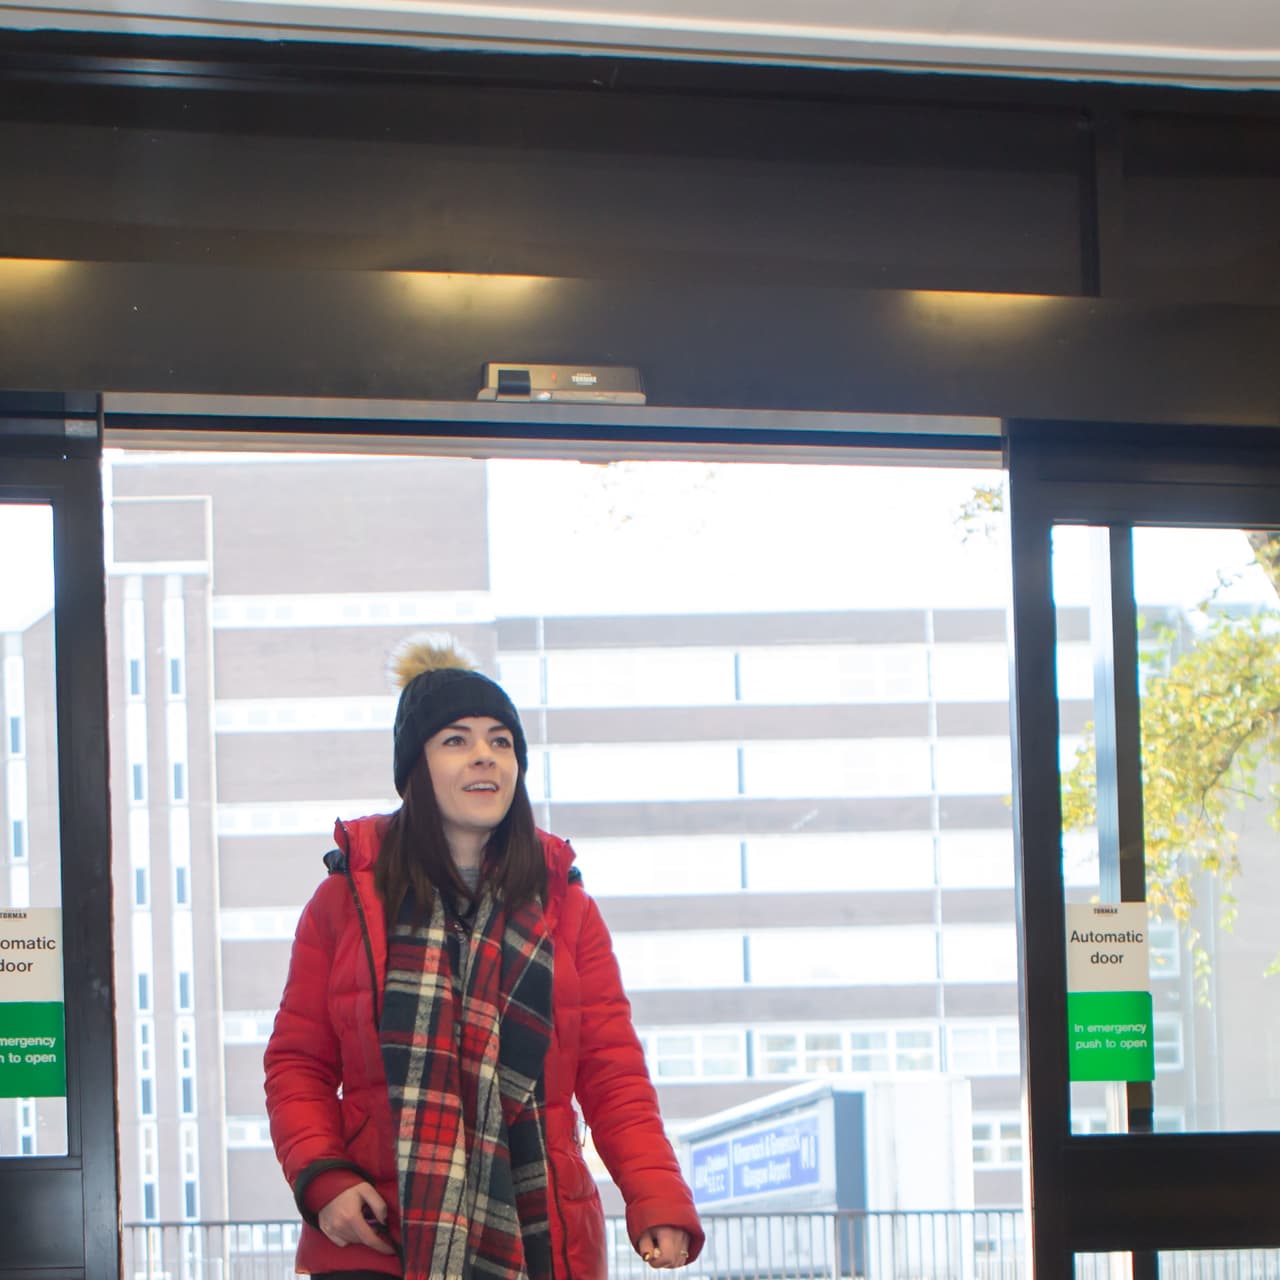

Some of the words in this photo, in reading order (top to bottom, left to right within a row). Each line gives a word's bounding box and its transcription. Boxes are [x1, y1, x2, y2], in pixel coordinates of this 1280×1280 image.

[1070, 930, 1144, 943] Automatic
[1090, 951, 1124, 964] door
[1074, 1024, 1084, 1033] In
[1087, 1023, 1147, 1034] emergency
[1075, 1039, 1101, 1050] push
[1106, 1040, 1116, 1048] to
[1120, 1040, 1147, 1050] open
[8, 1053, 21, 1063] to
[25, 1053, 56, 1065] open
